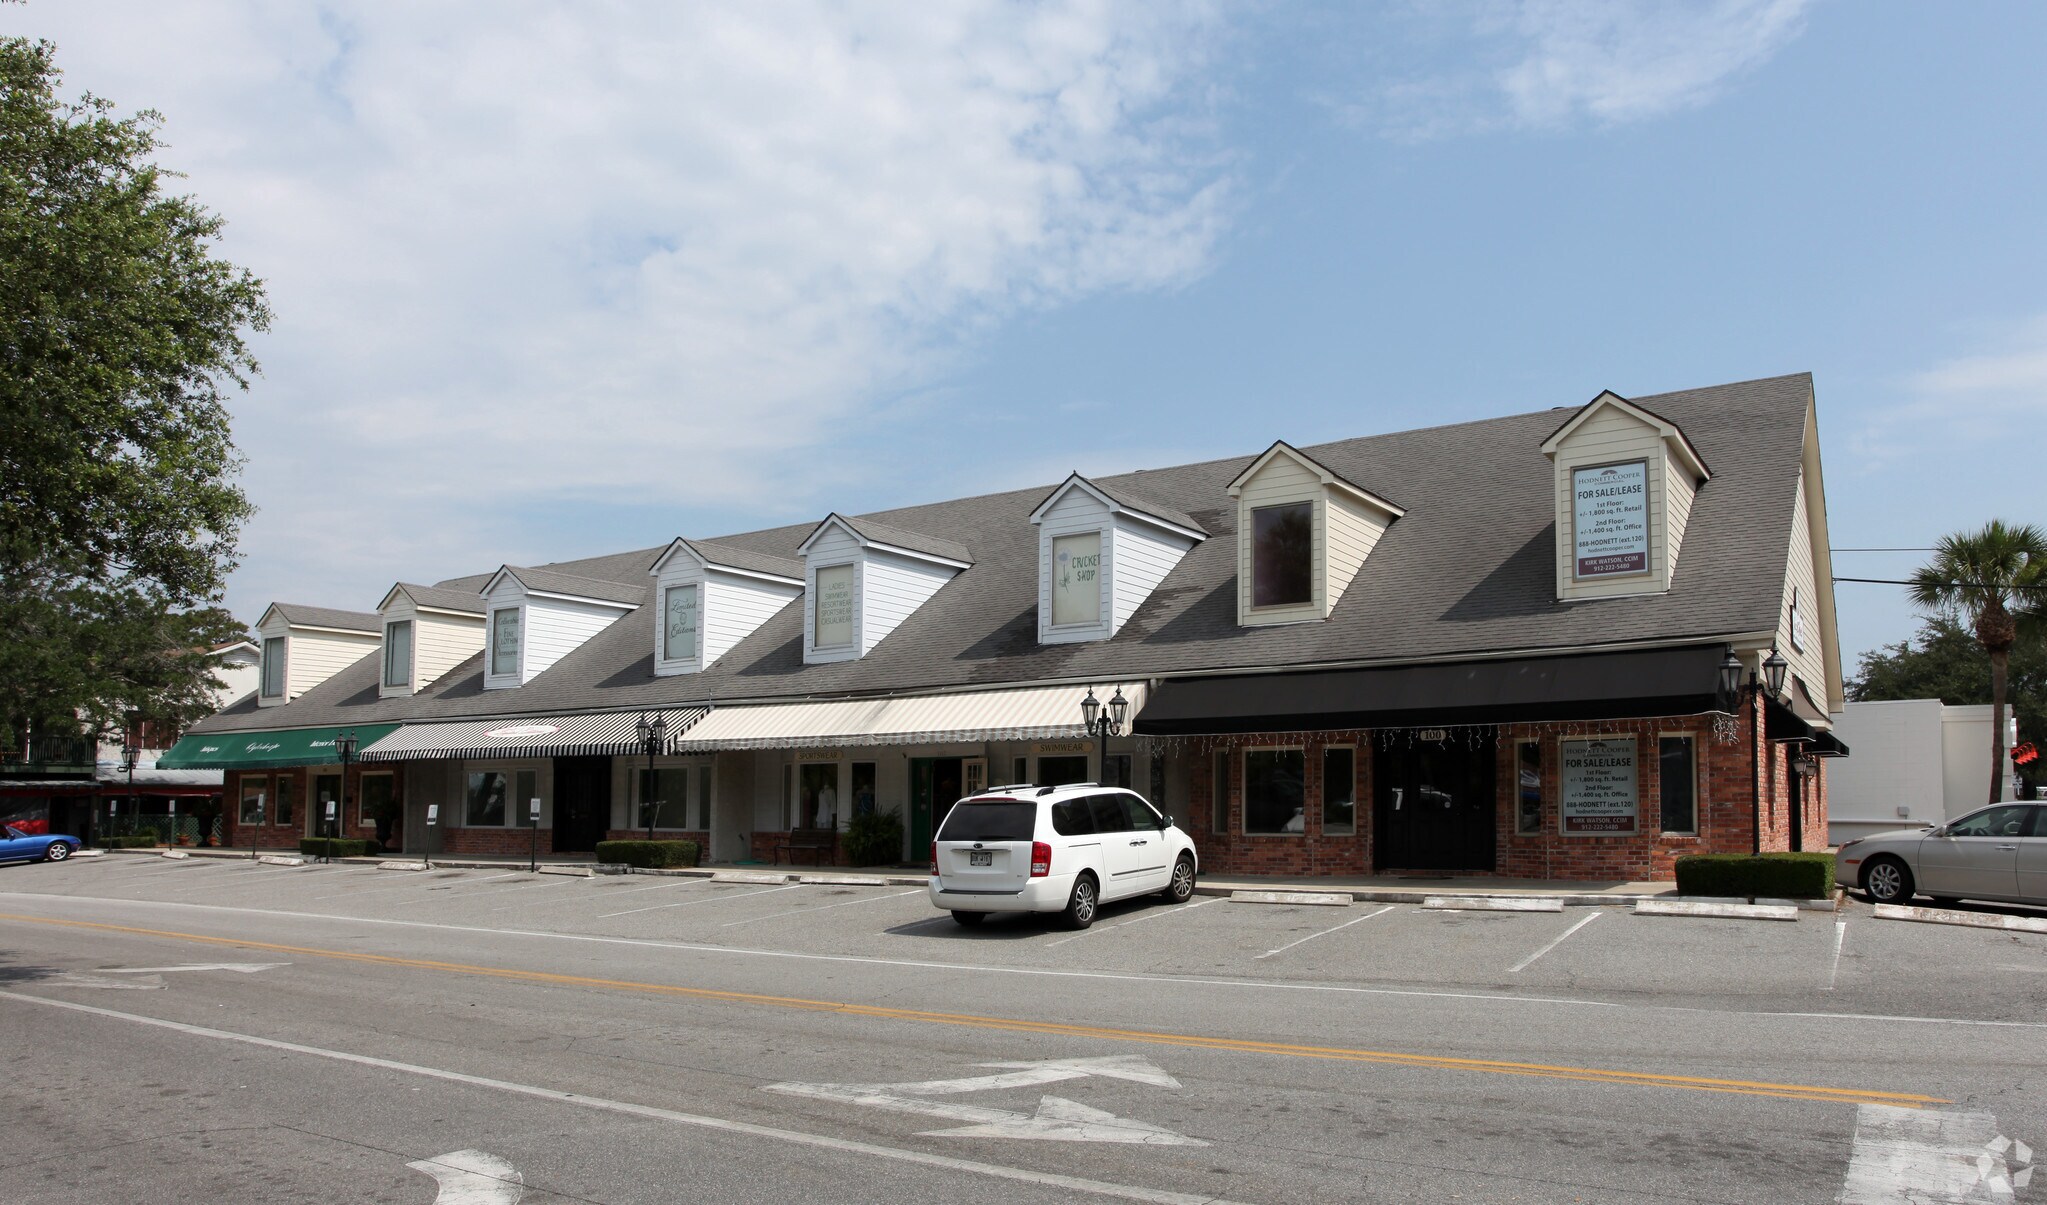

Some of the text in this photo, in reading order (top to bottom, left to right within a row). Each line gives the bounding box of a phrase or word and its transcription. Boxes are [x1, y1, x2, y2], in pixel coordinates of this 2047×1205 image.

[1578, 476, 1610, 484] HODNETT
[1578, 484, 1642, 500] FOR SALE/LEASE
[1579, 538, 1618, 548] 888-HODNETT
[1072, 554, 1100, 568] CRICKET
[1077, 570, 1095, 582] SHOP
[828, 582, 845, 590] LADIES
[821, 608, 852, 617] SPORTSWEAR
[1424, 731, 1441, 739] 100
[1040, 743, 1083, 752] SWIMWEAR
[799, 751, 837, 759] SPORTSWEAR
[1566, 757, 1631, 768] FOR SALE/LEASE
